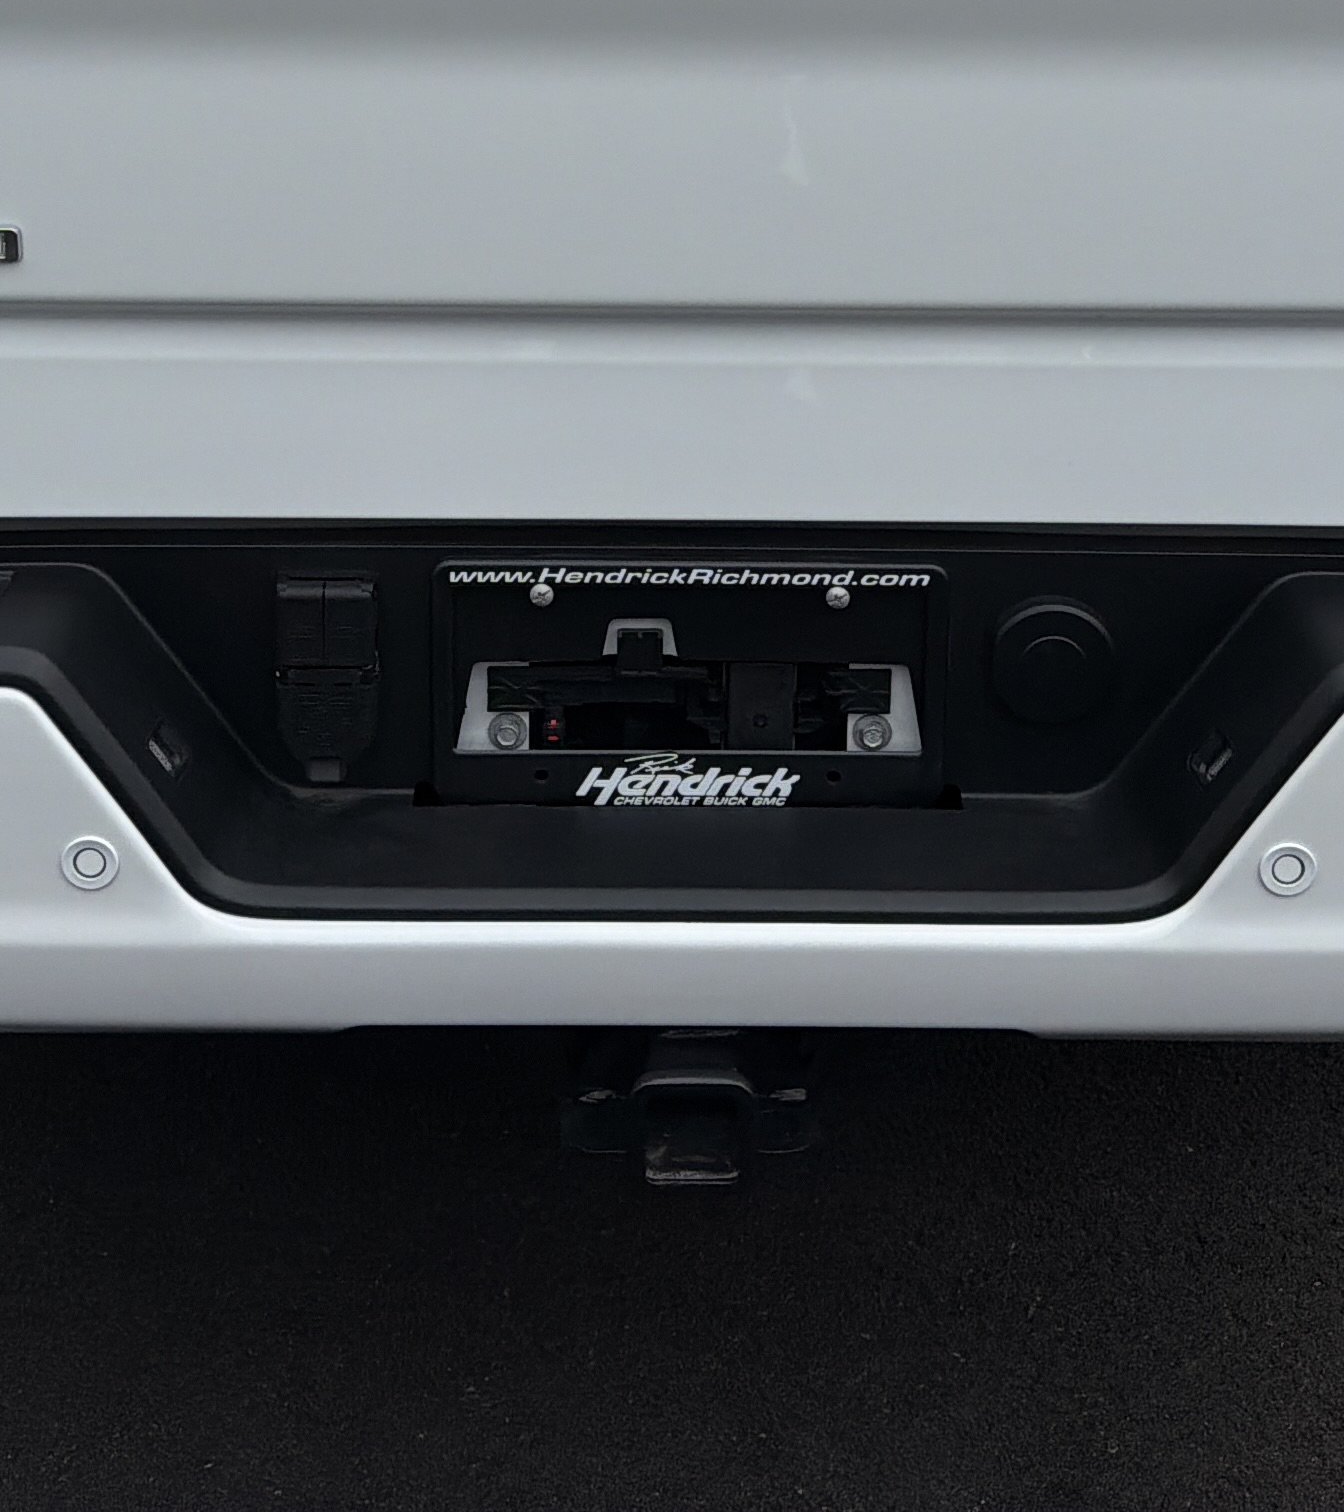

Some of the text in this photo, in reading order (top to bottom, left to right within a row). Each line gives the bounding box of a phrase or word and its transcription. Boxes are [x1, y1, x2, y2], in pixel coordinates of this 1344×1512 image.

[449, 567, 930, 587] www.HendrickRichmond.com
[575, 767, 801, 805] Hendrick
[613, 797, 786, 806] CHEVROLET BUICK GMC
